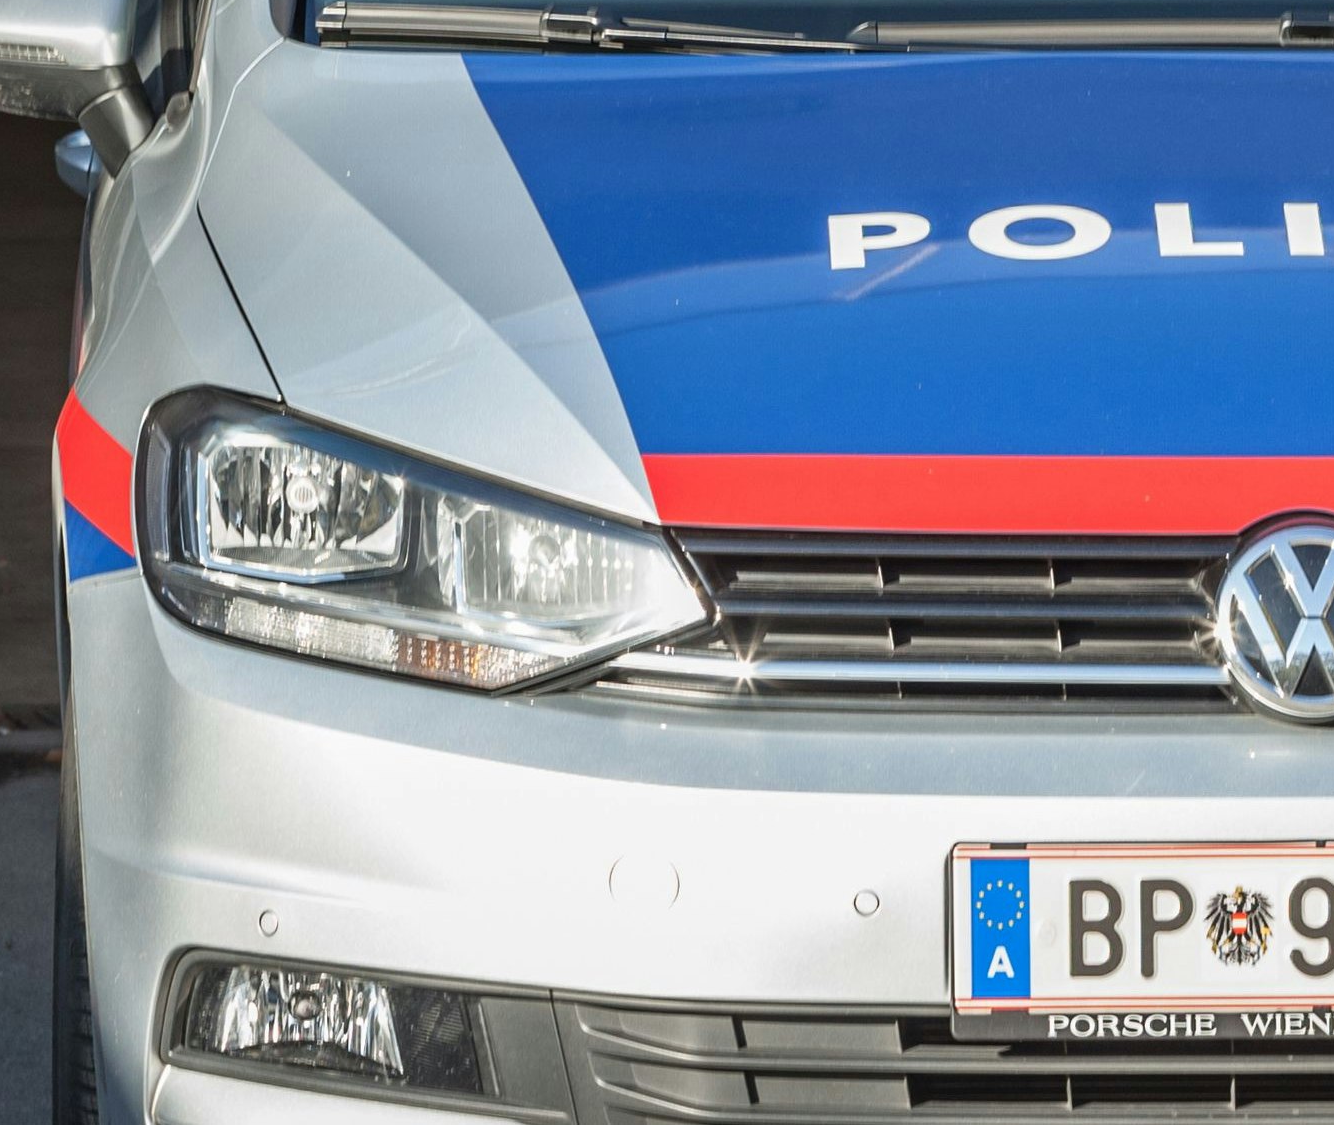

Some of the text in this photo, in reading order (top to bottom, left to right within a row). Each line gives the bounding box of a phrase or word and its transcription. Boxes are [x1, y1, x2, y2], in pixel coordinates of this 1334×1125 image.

[1068, 878, 1195, 979] BP
[987, 946, 1015, 979] A
[1047, 1013, 1218, 1039] PORSCHE
